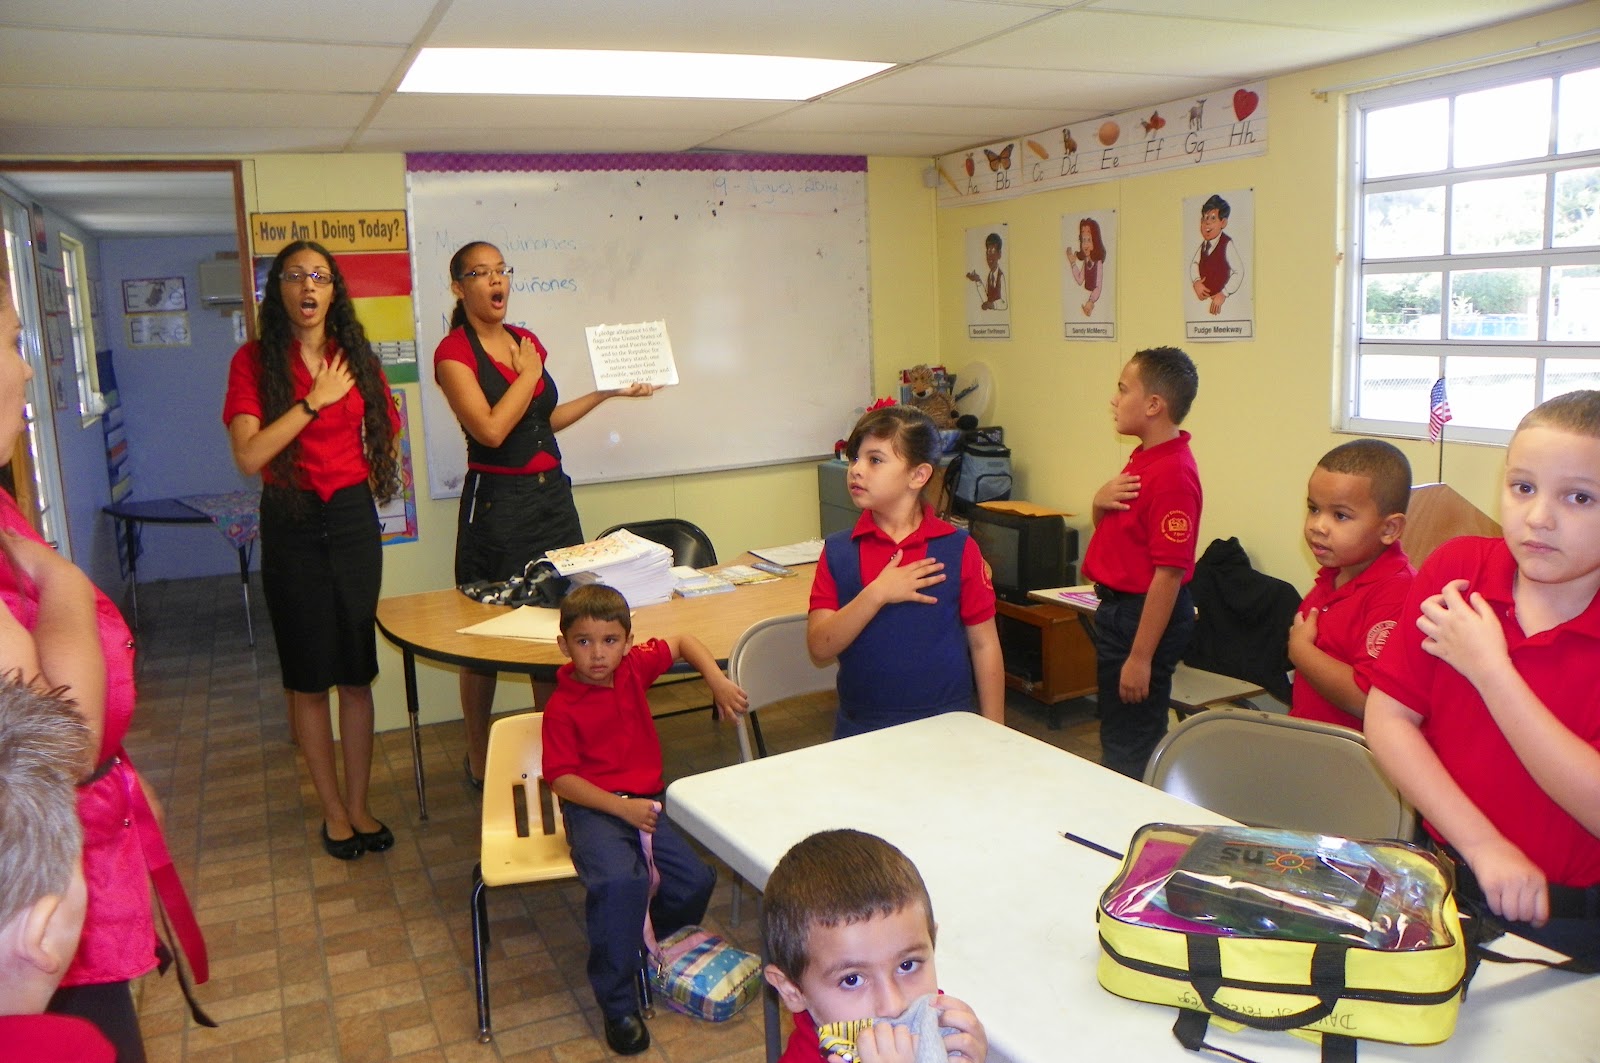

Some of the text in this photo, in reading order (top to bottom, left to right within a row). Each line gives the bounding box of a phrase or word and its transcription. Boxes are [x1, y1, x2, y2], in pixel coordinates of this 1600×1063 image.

[967, 121, 1257, 195] Aa Bb Cc Dd Ee Ff Gg Hh
[259, 218, 400, 243] How Am I Doing Today?
[616, 328, 642, 336] allegiance
[1194, 325, 1243, 335] Pudge Meekway
